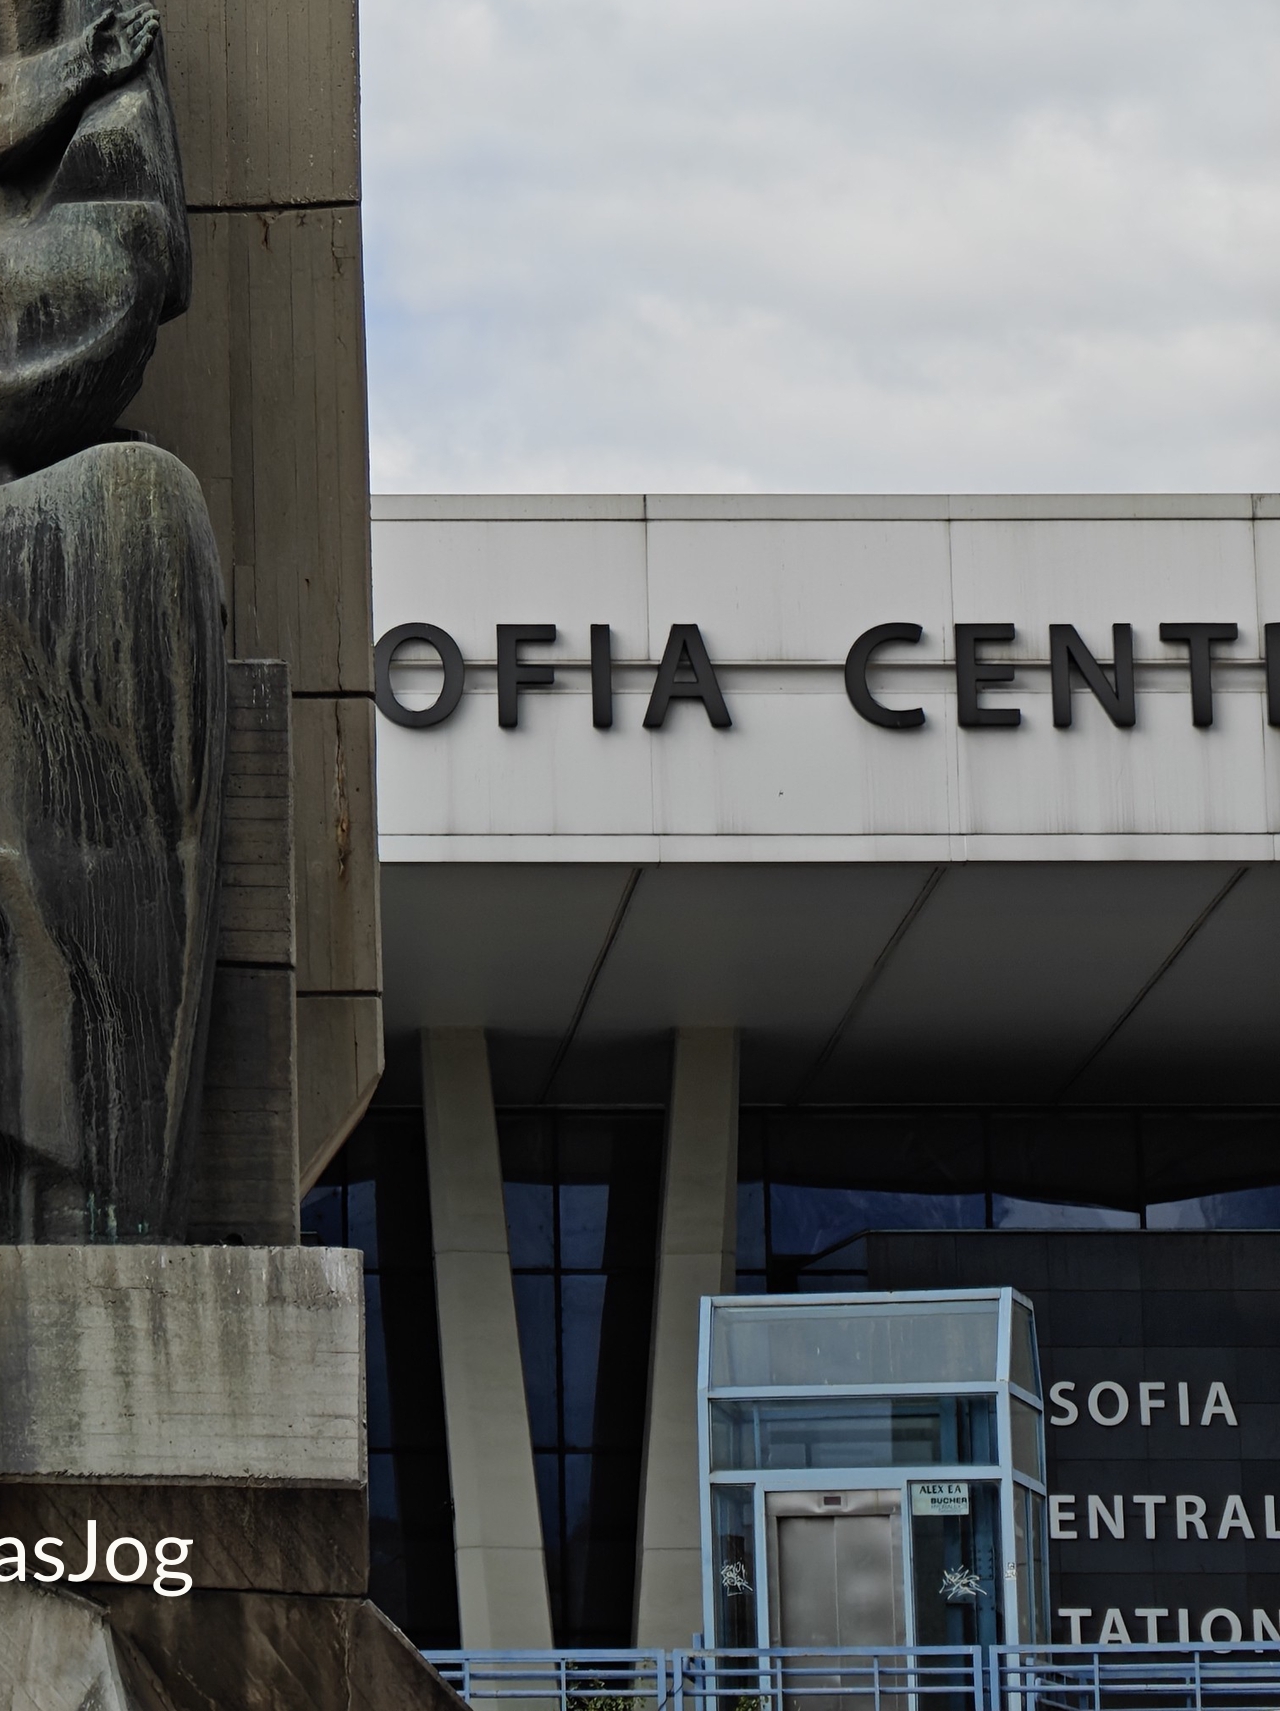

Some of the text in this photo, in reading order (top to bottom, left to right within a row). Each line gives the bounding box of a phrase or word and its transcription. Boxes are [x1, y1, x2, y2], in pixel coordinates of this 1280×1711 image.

[374, 622, 733, 729] OFIA
[1049, 1381, 1238, 1426] SOFIA
[919, 1485, 944, 1494] ALEX
[1049, 1494, 1280, 1540] ENTRAL
[1058, 1607, 1280, 1653] TATION
